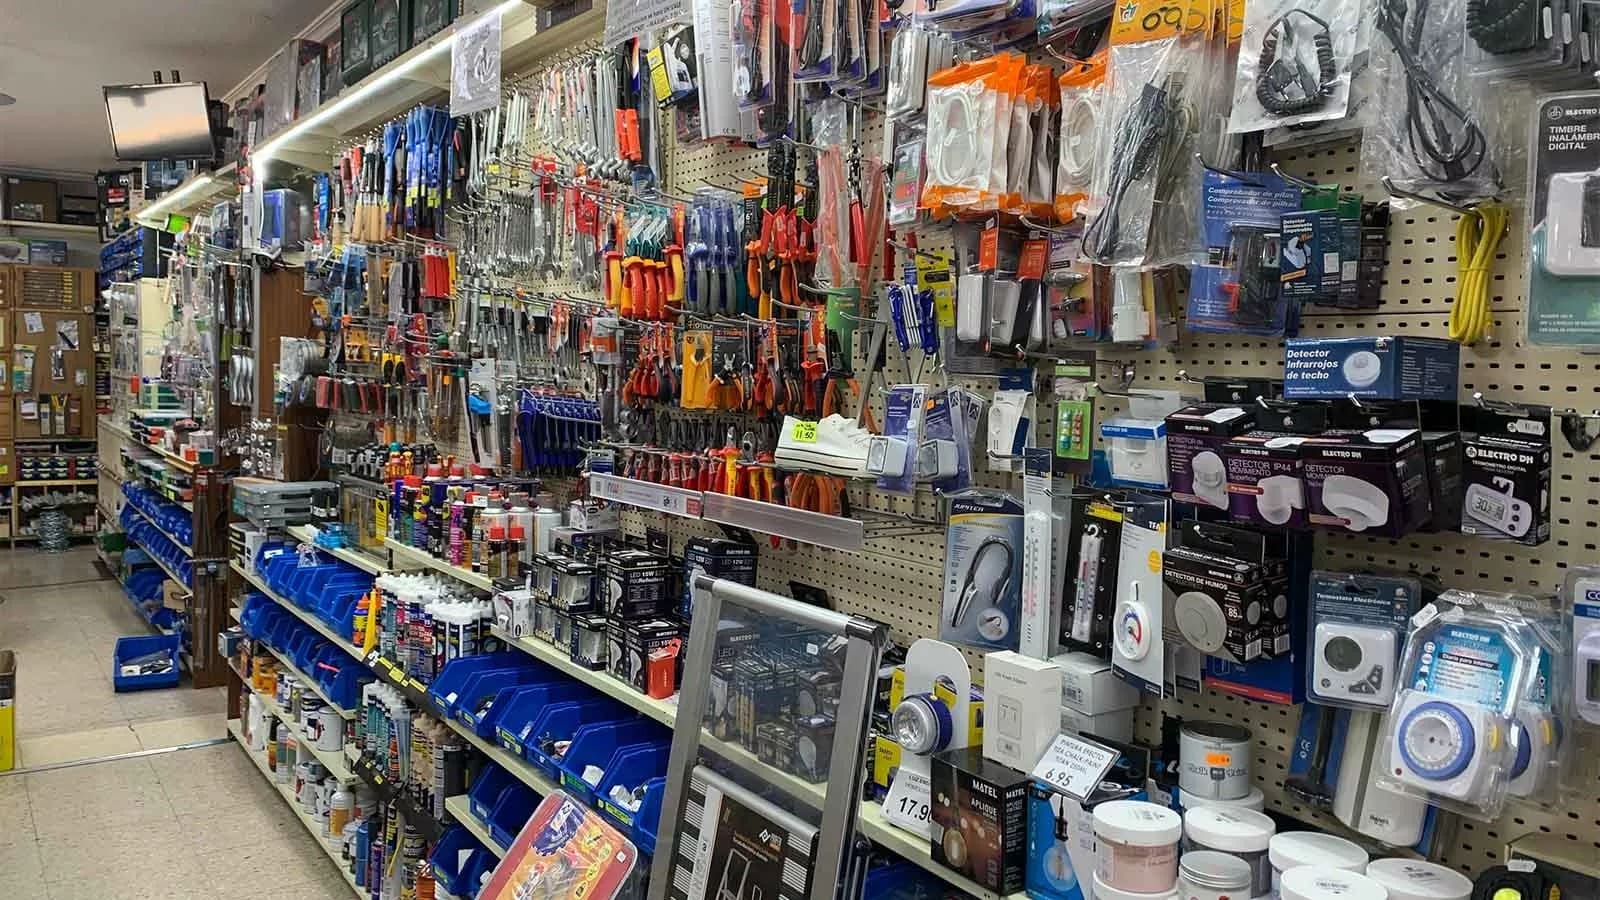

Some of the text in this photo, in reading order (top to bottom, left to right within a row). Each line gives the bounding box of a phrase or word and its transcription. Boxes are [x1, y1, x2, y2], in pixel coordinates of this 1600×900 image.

[1549, 125, 1587, 133] TIMBRE
[1549, 142, 1587, 151] DIGITAL
[1208, 187, 1260, 196] Comprobador
[1208, 196, 1259, 205] Comprovador
[1272, 200, 1297, 208] pilhas
[1287, 349, 1330, 358] Detector
[1287, 360, 1338, 369] Infrarrojos
[1287, 371, 1329, 380] de techo
[1322, 450, 1350, 458] ELECTRO
[1478, 449, 1533, 464] ELECTRO DH
[1228, 458, 1291, 472] DETECTOR IP44
[1305, 464, 1344, 473] DETECTOR
[1507, 464, 1527, 473] DIGITAL
[1165, 569, 1228, 591] DETECTOR DE HUMOS
[1316, 592, 1352, 601] Termostato
[1228, 607, 1238, 618] 85
[719, 648, 735, 658] LED
[1083, 747, 1105, 761] EFECTO
[1045, 768, 1073, 787] 6.95
[972, 779, 998, 799] MATEL
[1006, 788, 1025, 799] MATEL
[971, 797, 998, 816] APLIQUE
